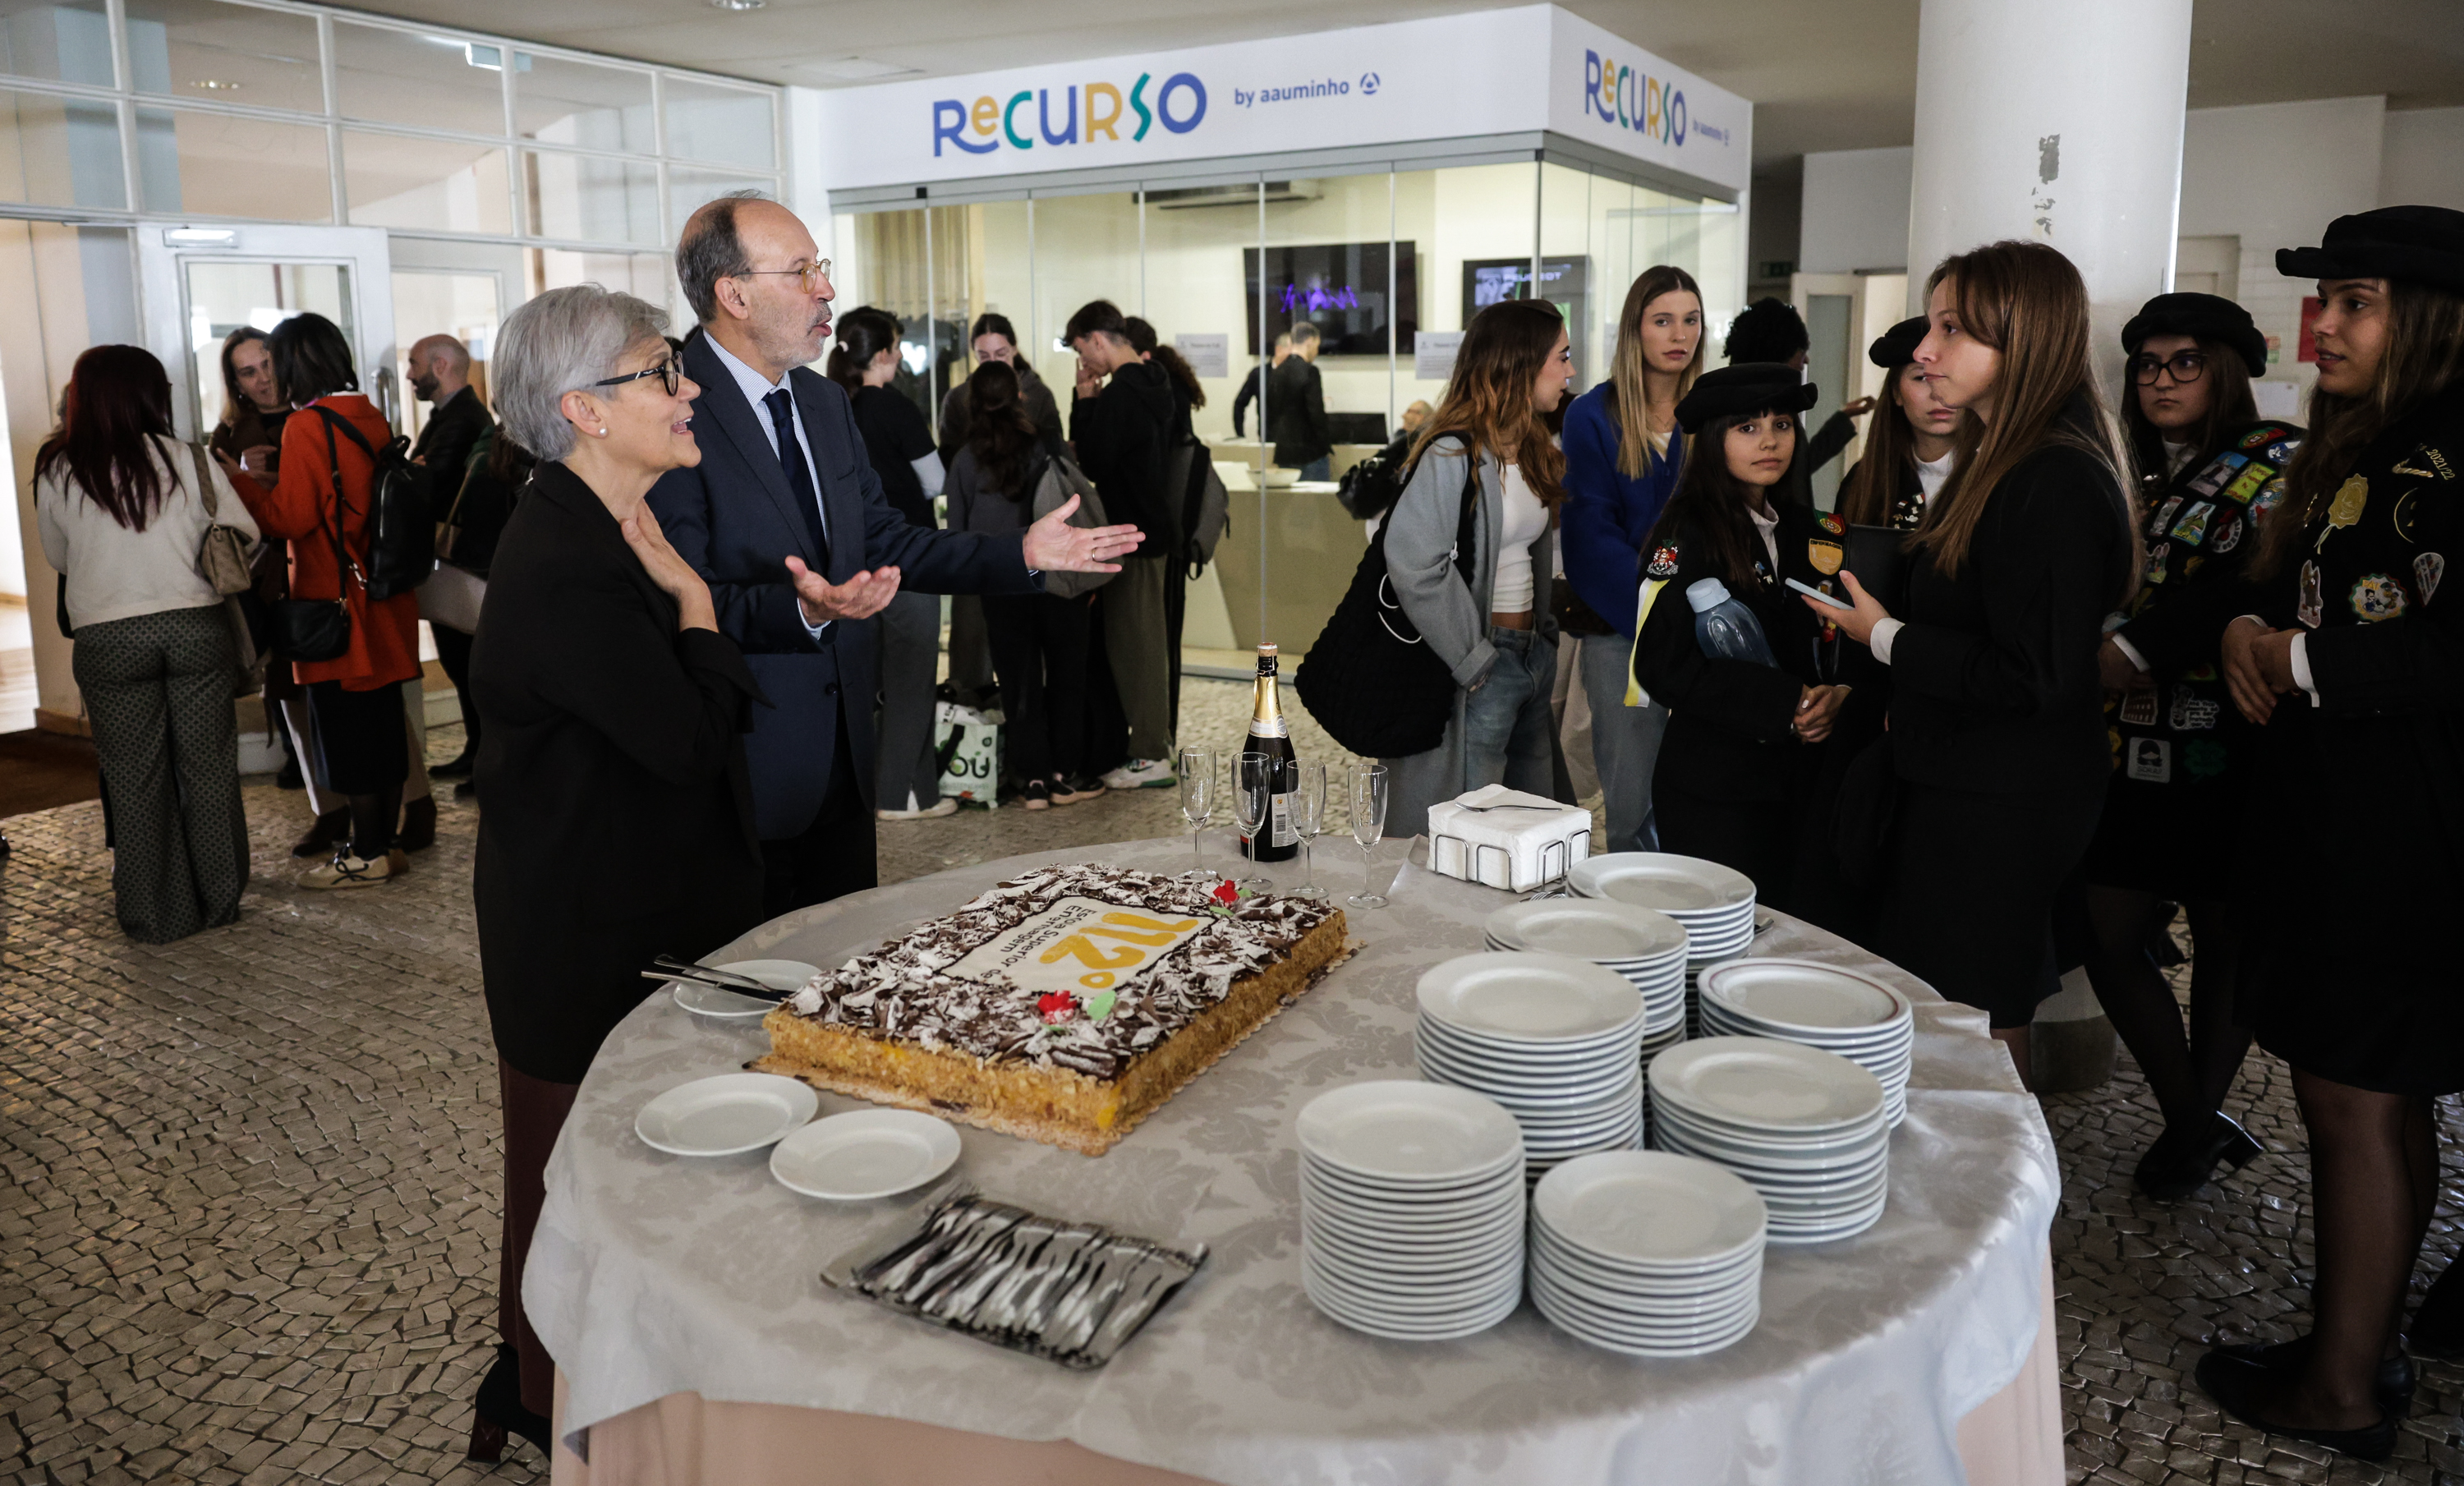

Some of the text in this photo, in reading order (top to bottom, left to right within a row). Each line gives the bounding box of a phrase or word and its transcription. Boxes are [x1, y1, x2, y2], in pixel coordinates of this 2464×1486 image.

[1234, 88, 1254, 108] by
[1260, 79, 1349, 102] aauminho
[2425, 449, 2455, 480] 2021/22
[1000, 904, 1083, 953] Enermagem
[1000, 930, 1060, 968] Superior
[981, 968, 1002, 979] de
